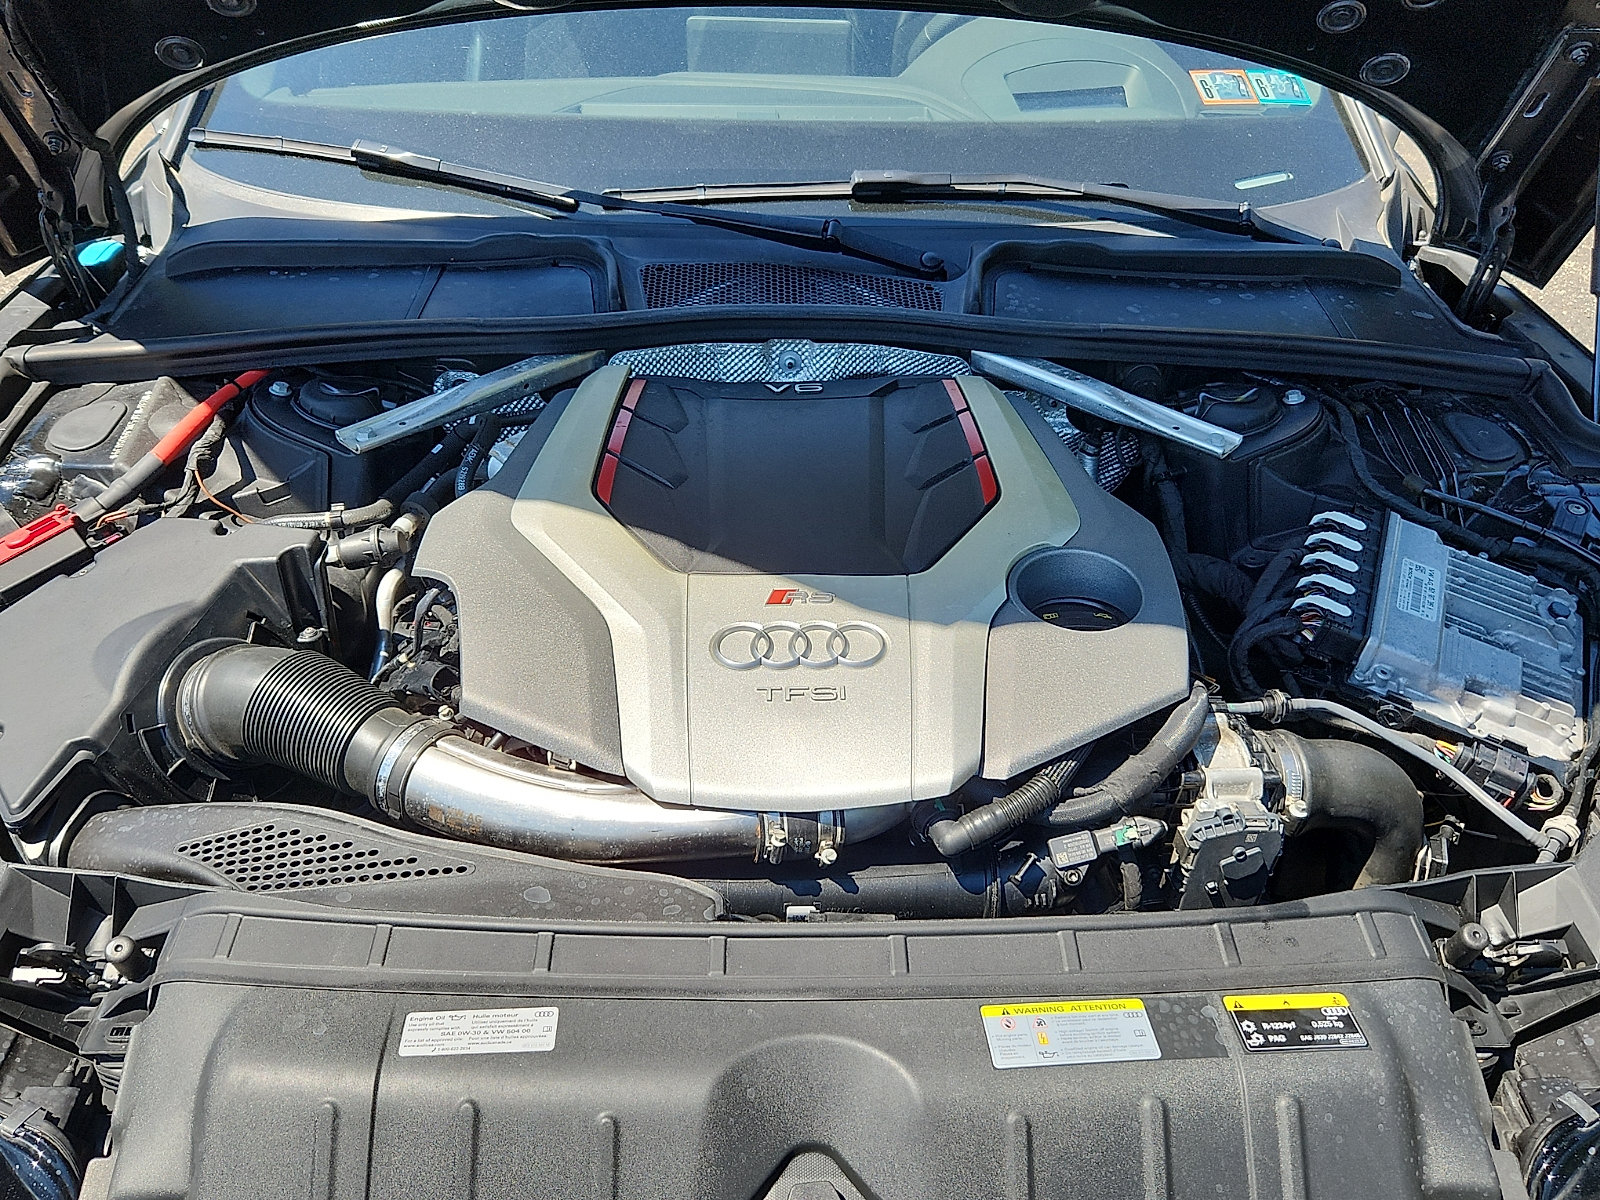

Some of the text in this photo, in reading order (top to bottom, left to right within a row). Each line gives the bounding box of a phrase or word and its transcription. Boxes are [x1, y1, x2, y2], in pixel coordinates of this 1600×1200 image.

[1199, 79, 1214, 99] 6
[1255, 78, 1270, 98] 6
[763, 382, 824, 393] V6
[778, 589, 836, 605] RS
[756, 685, 847, 702] TFSI
[1013, 1002, 1127, 1015] WARNING ATTENTION
[1268, 1034, 1288, 1043] PAG
